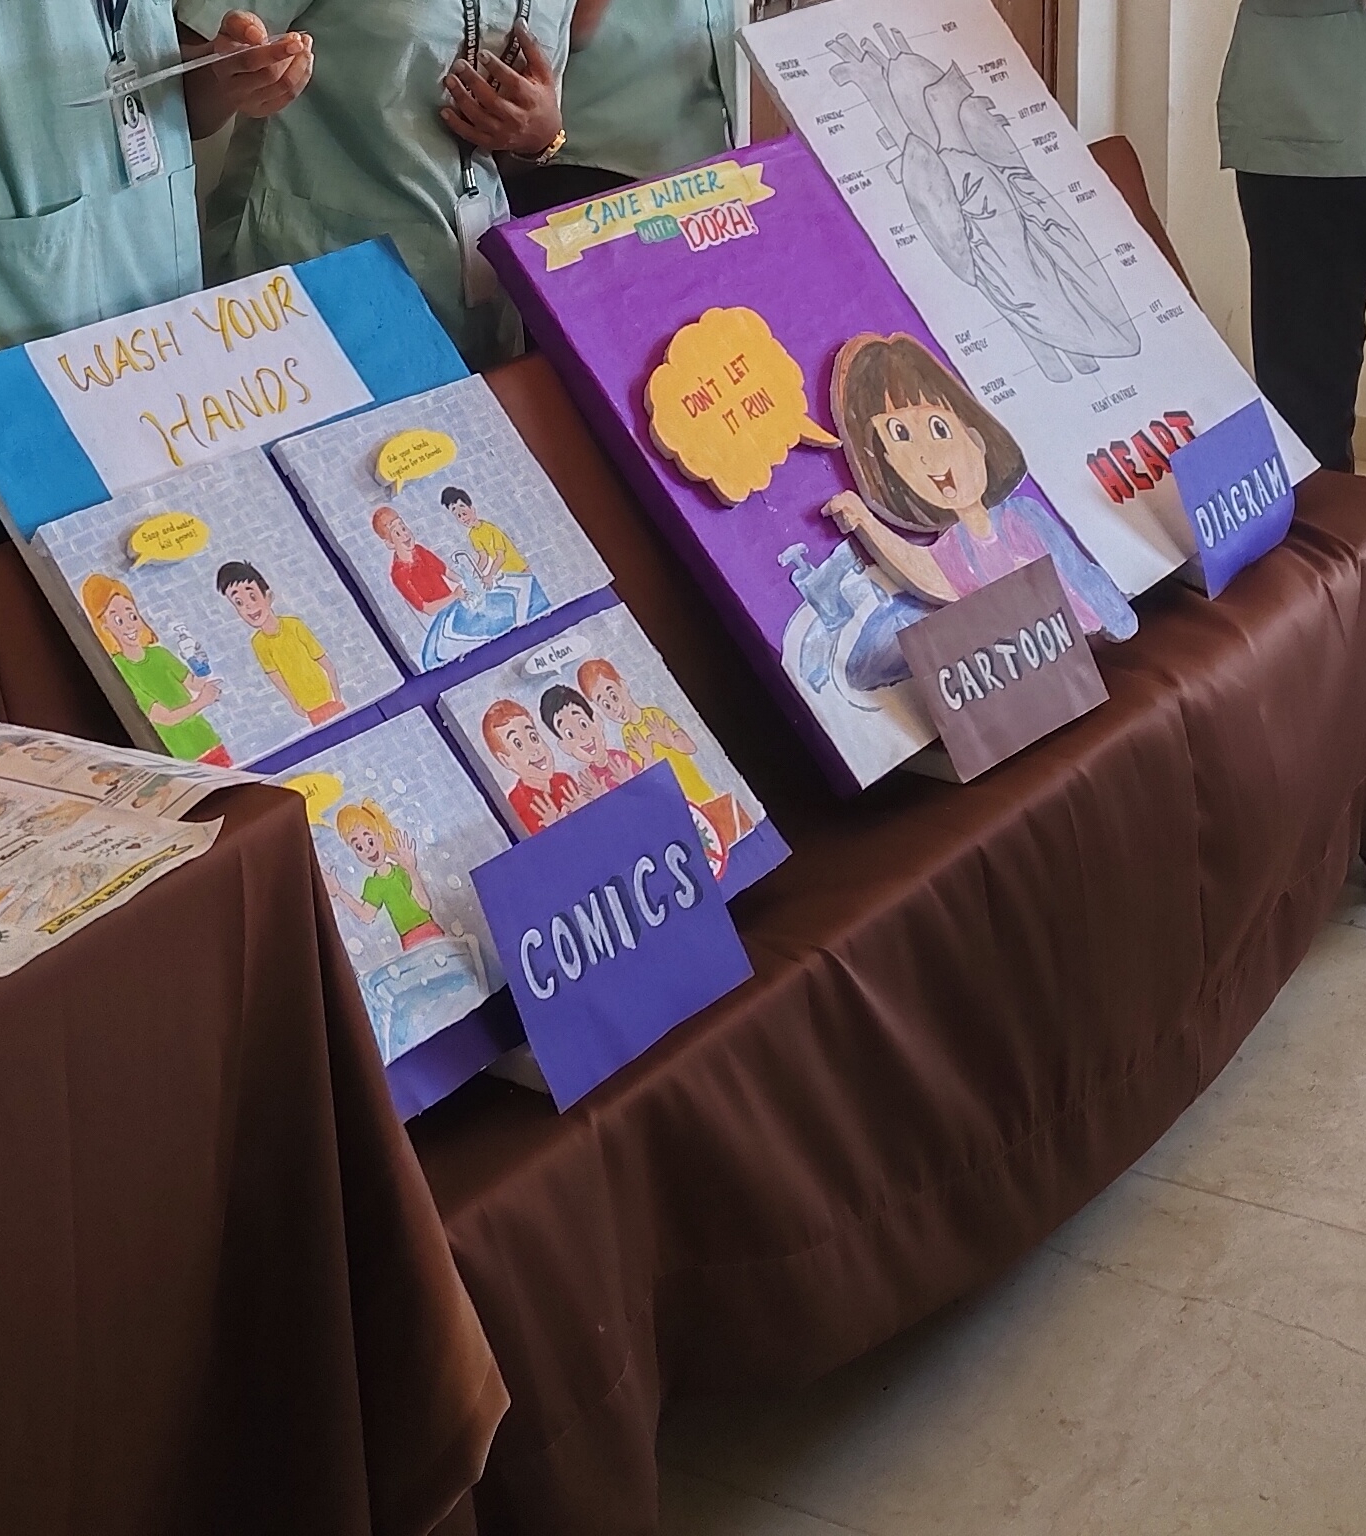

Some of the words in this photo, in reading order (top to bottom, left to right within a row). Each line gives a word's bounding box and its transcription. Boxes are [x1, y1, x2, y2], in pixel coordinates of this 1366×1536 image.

[585, 192, 642, 234] SAVE
[650, 170, 725, 209] WATER
[1068, 181, 1083, 193] LEFT
[638, 216, 676, 241] WITH
[679, 200, 758, 249] DORA!
[1114, 241, 1135, 256] MITRAL
[57, 320, 183, 392] WASH
[191, 275, 309, 353] YOUR
[1149, 299, 1164, 313] LEFT
[139, 357, 311, 467] HANDS
[681, 376, 723, 419] DON'T
[723, 353, 750, 385] LET
[721, 408, 740, 435] IT
[740, 387, 775, 420] RUN
[1091, 394, 1112, 414] RIGHT
[1087, 410, 1197, 504] HEART
[1194, 454, 1288, 549] DIAGRAM
[141, 531, 160, 543] Soap
[162, 522, 176, 535] and
[176, 518, 194, 530] water
[548, 645, 573, 662] clean
[938, 607, 1075, 711] CARTOON
[520, 839, 704, 1001] COMICS
